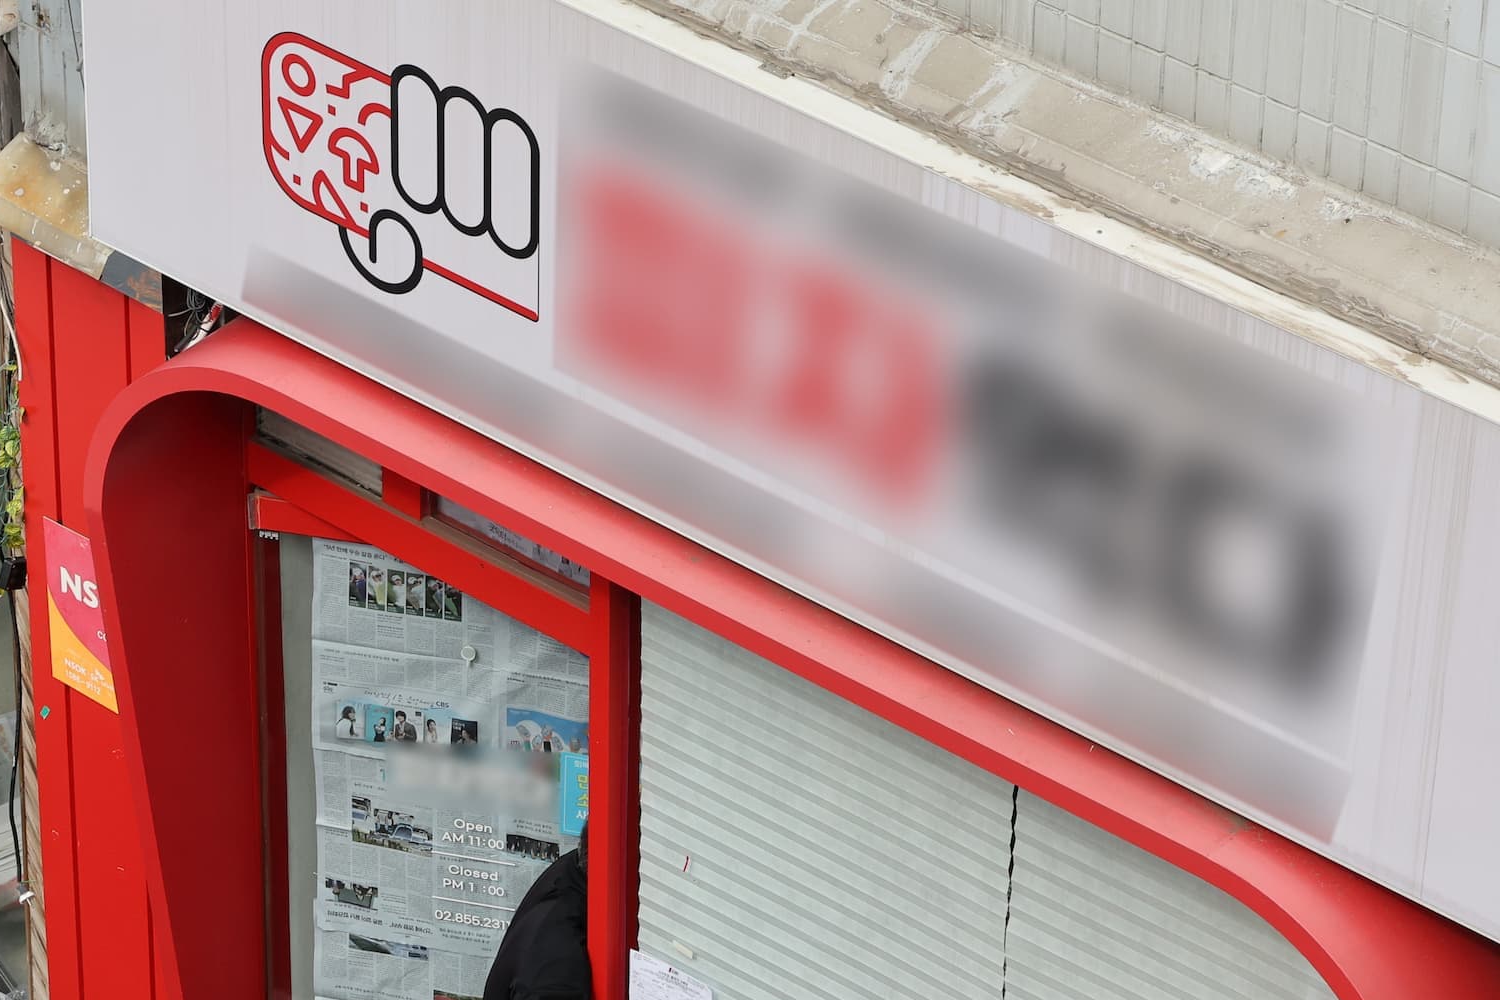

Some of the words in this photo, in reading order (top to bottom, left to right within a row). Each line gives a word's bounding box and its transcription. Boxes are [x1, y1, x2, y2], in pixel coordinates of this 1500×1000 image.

[454, 818, 492, 834] Open
[442, 832, 464, 844] AM
[469, 836, 504, 851] 11:00
[448, 864, 499, 881] Closed
[442, 878, 464, 891] PM
